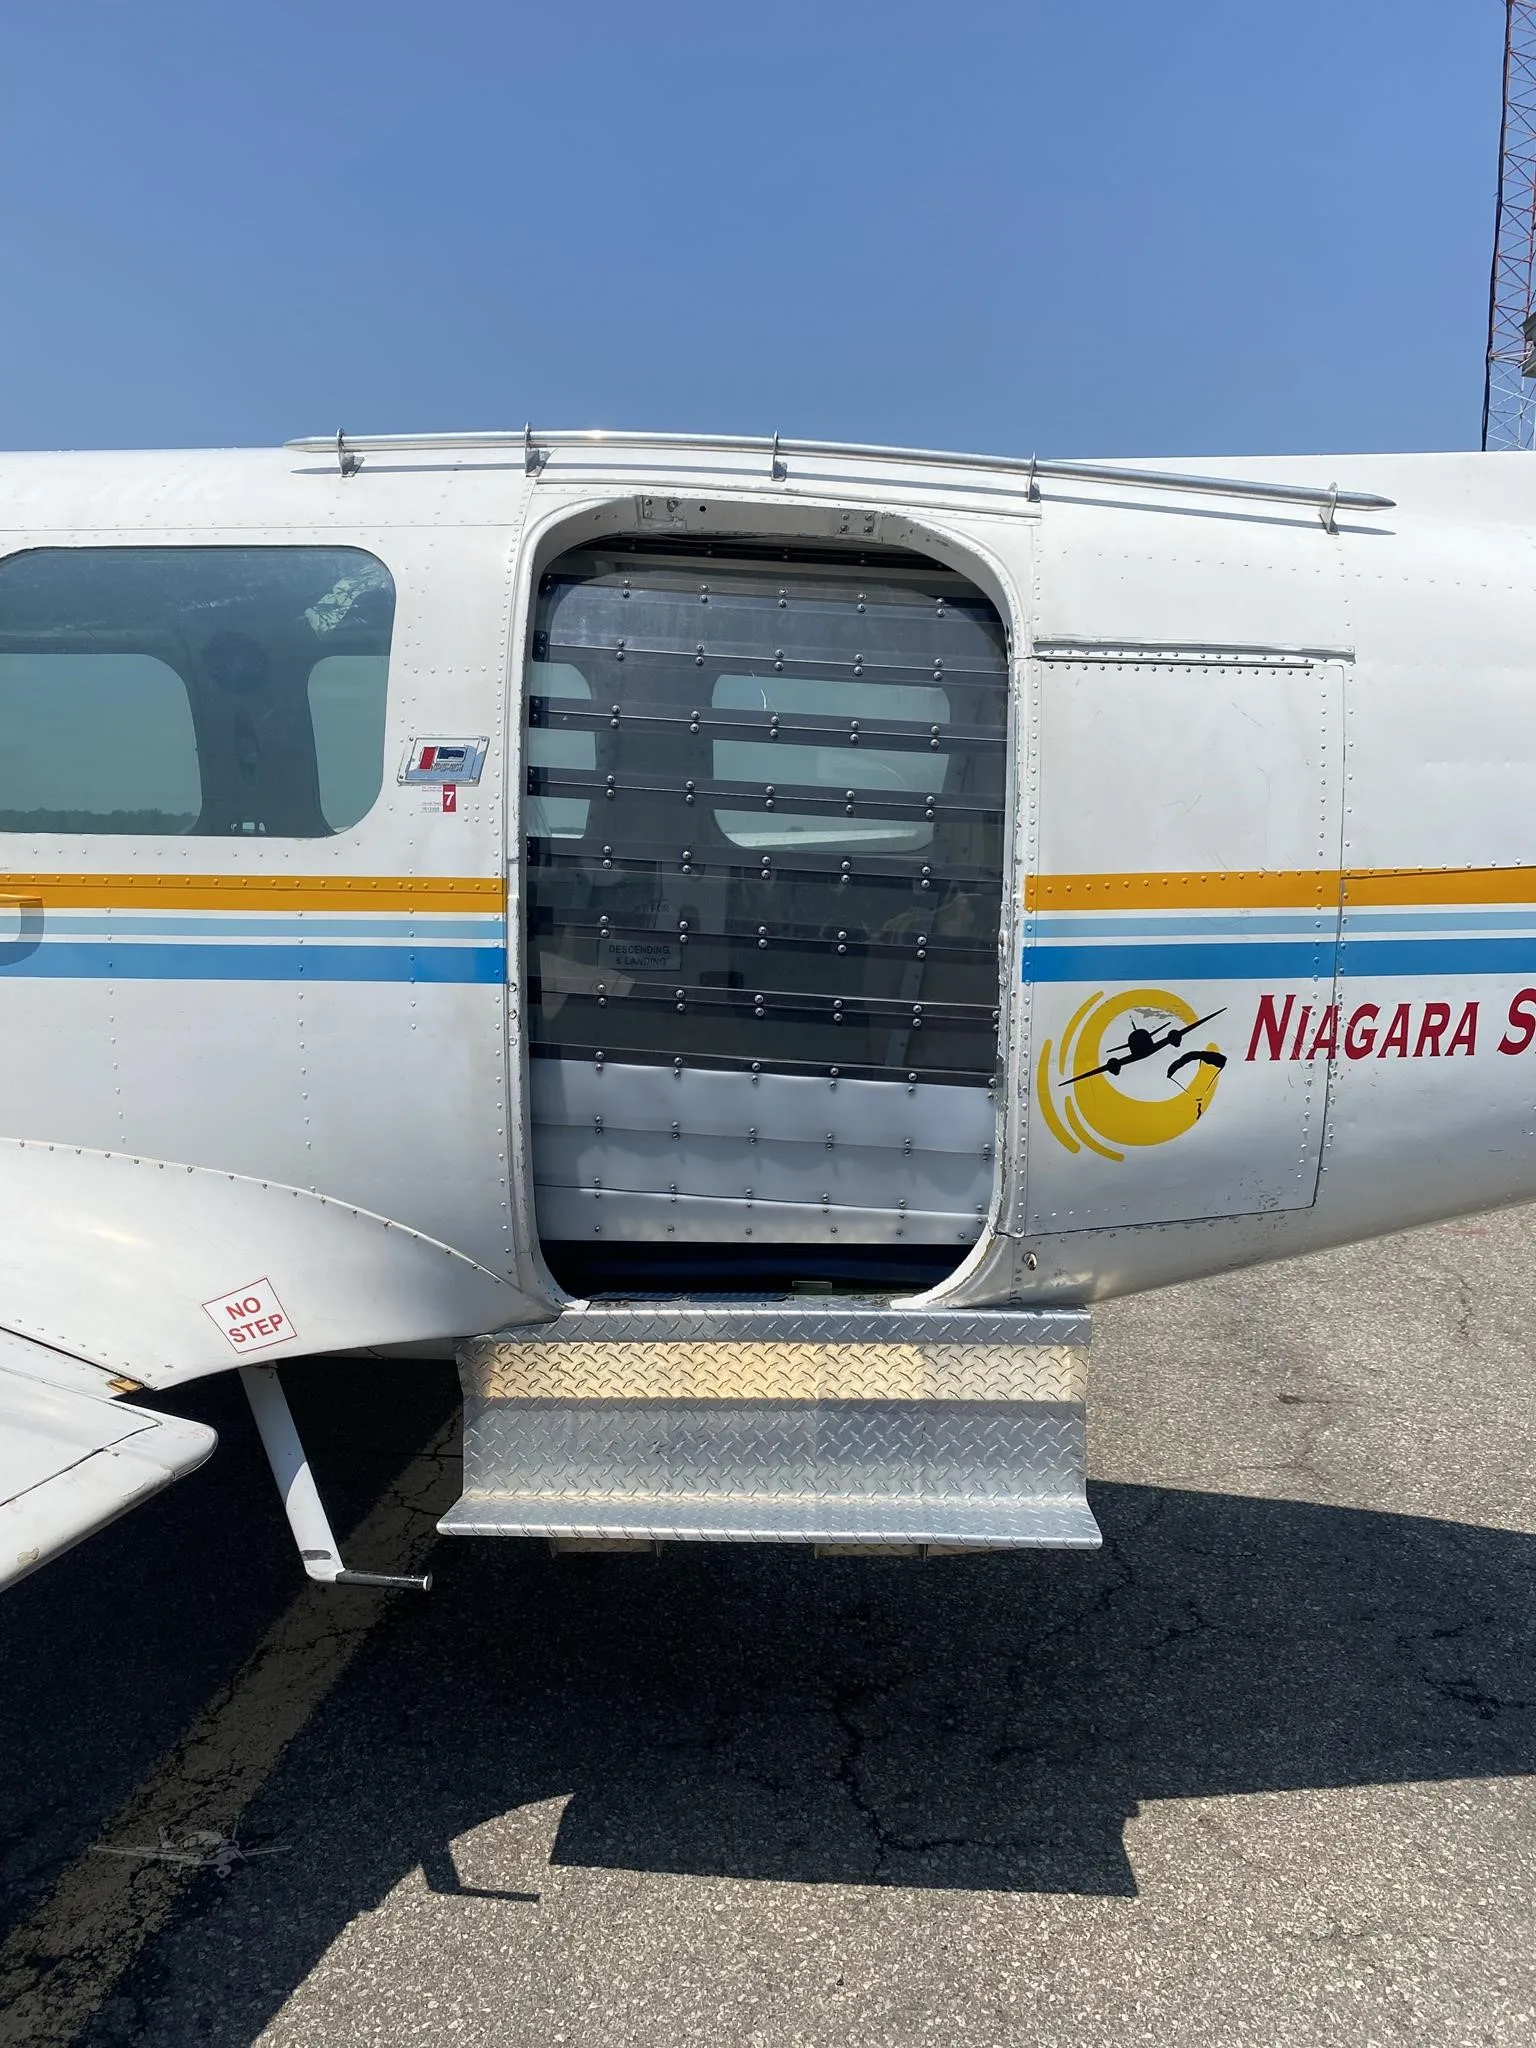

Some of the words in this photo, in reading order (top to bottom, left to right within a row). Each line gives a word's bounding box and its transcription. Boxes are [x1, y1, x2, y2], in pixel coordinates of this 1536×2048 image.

[443, 791, 455, 806] 7
[608, 944, 671, 955] DESCENDING
[624, 956, 667, 967] LANDING
[1244, 994, 1480, 1062] NIAGARA
[225, 1297, 261, 1320] NO
[228, 1313, 283, 1343] STEP
